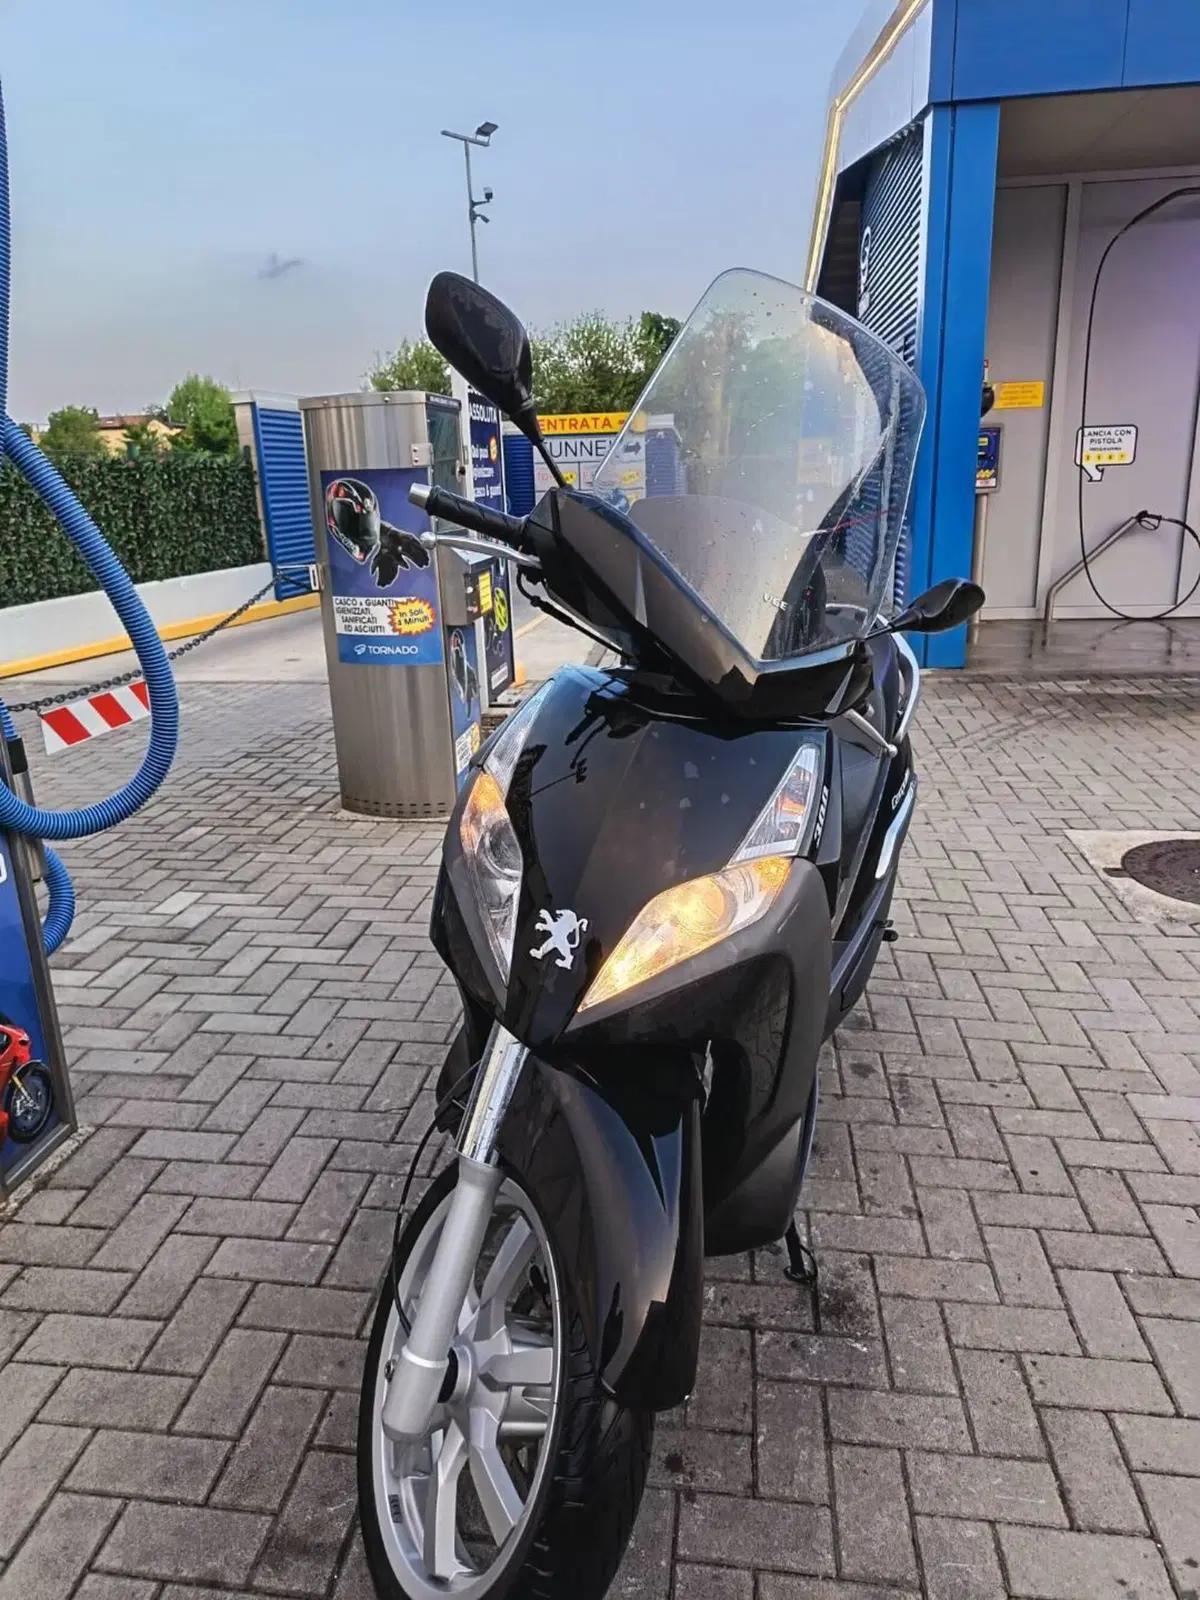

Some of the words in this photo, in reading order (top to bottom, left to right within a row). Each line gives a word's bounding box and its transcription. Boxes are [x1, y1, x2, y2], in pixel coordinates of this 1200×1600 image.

[469, 402, 498, 424] ASSOLUTA
[538, 417, 613, 432] ENTRATA
[543, 440, 619, 458] UNNE
[334, 598, 357, 606] CASCO
[365, 599, 394, 607] GUANTI
[341, 616, 377, 624] SANIFICATI
[344, 624, 353, 632] ED
[354, 625, 385, 633] ASCIUTTI
[368, 645, 418, 655] TORNADO
[814, 784, 829, 849] 300
